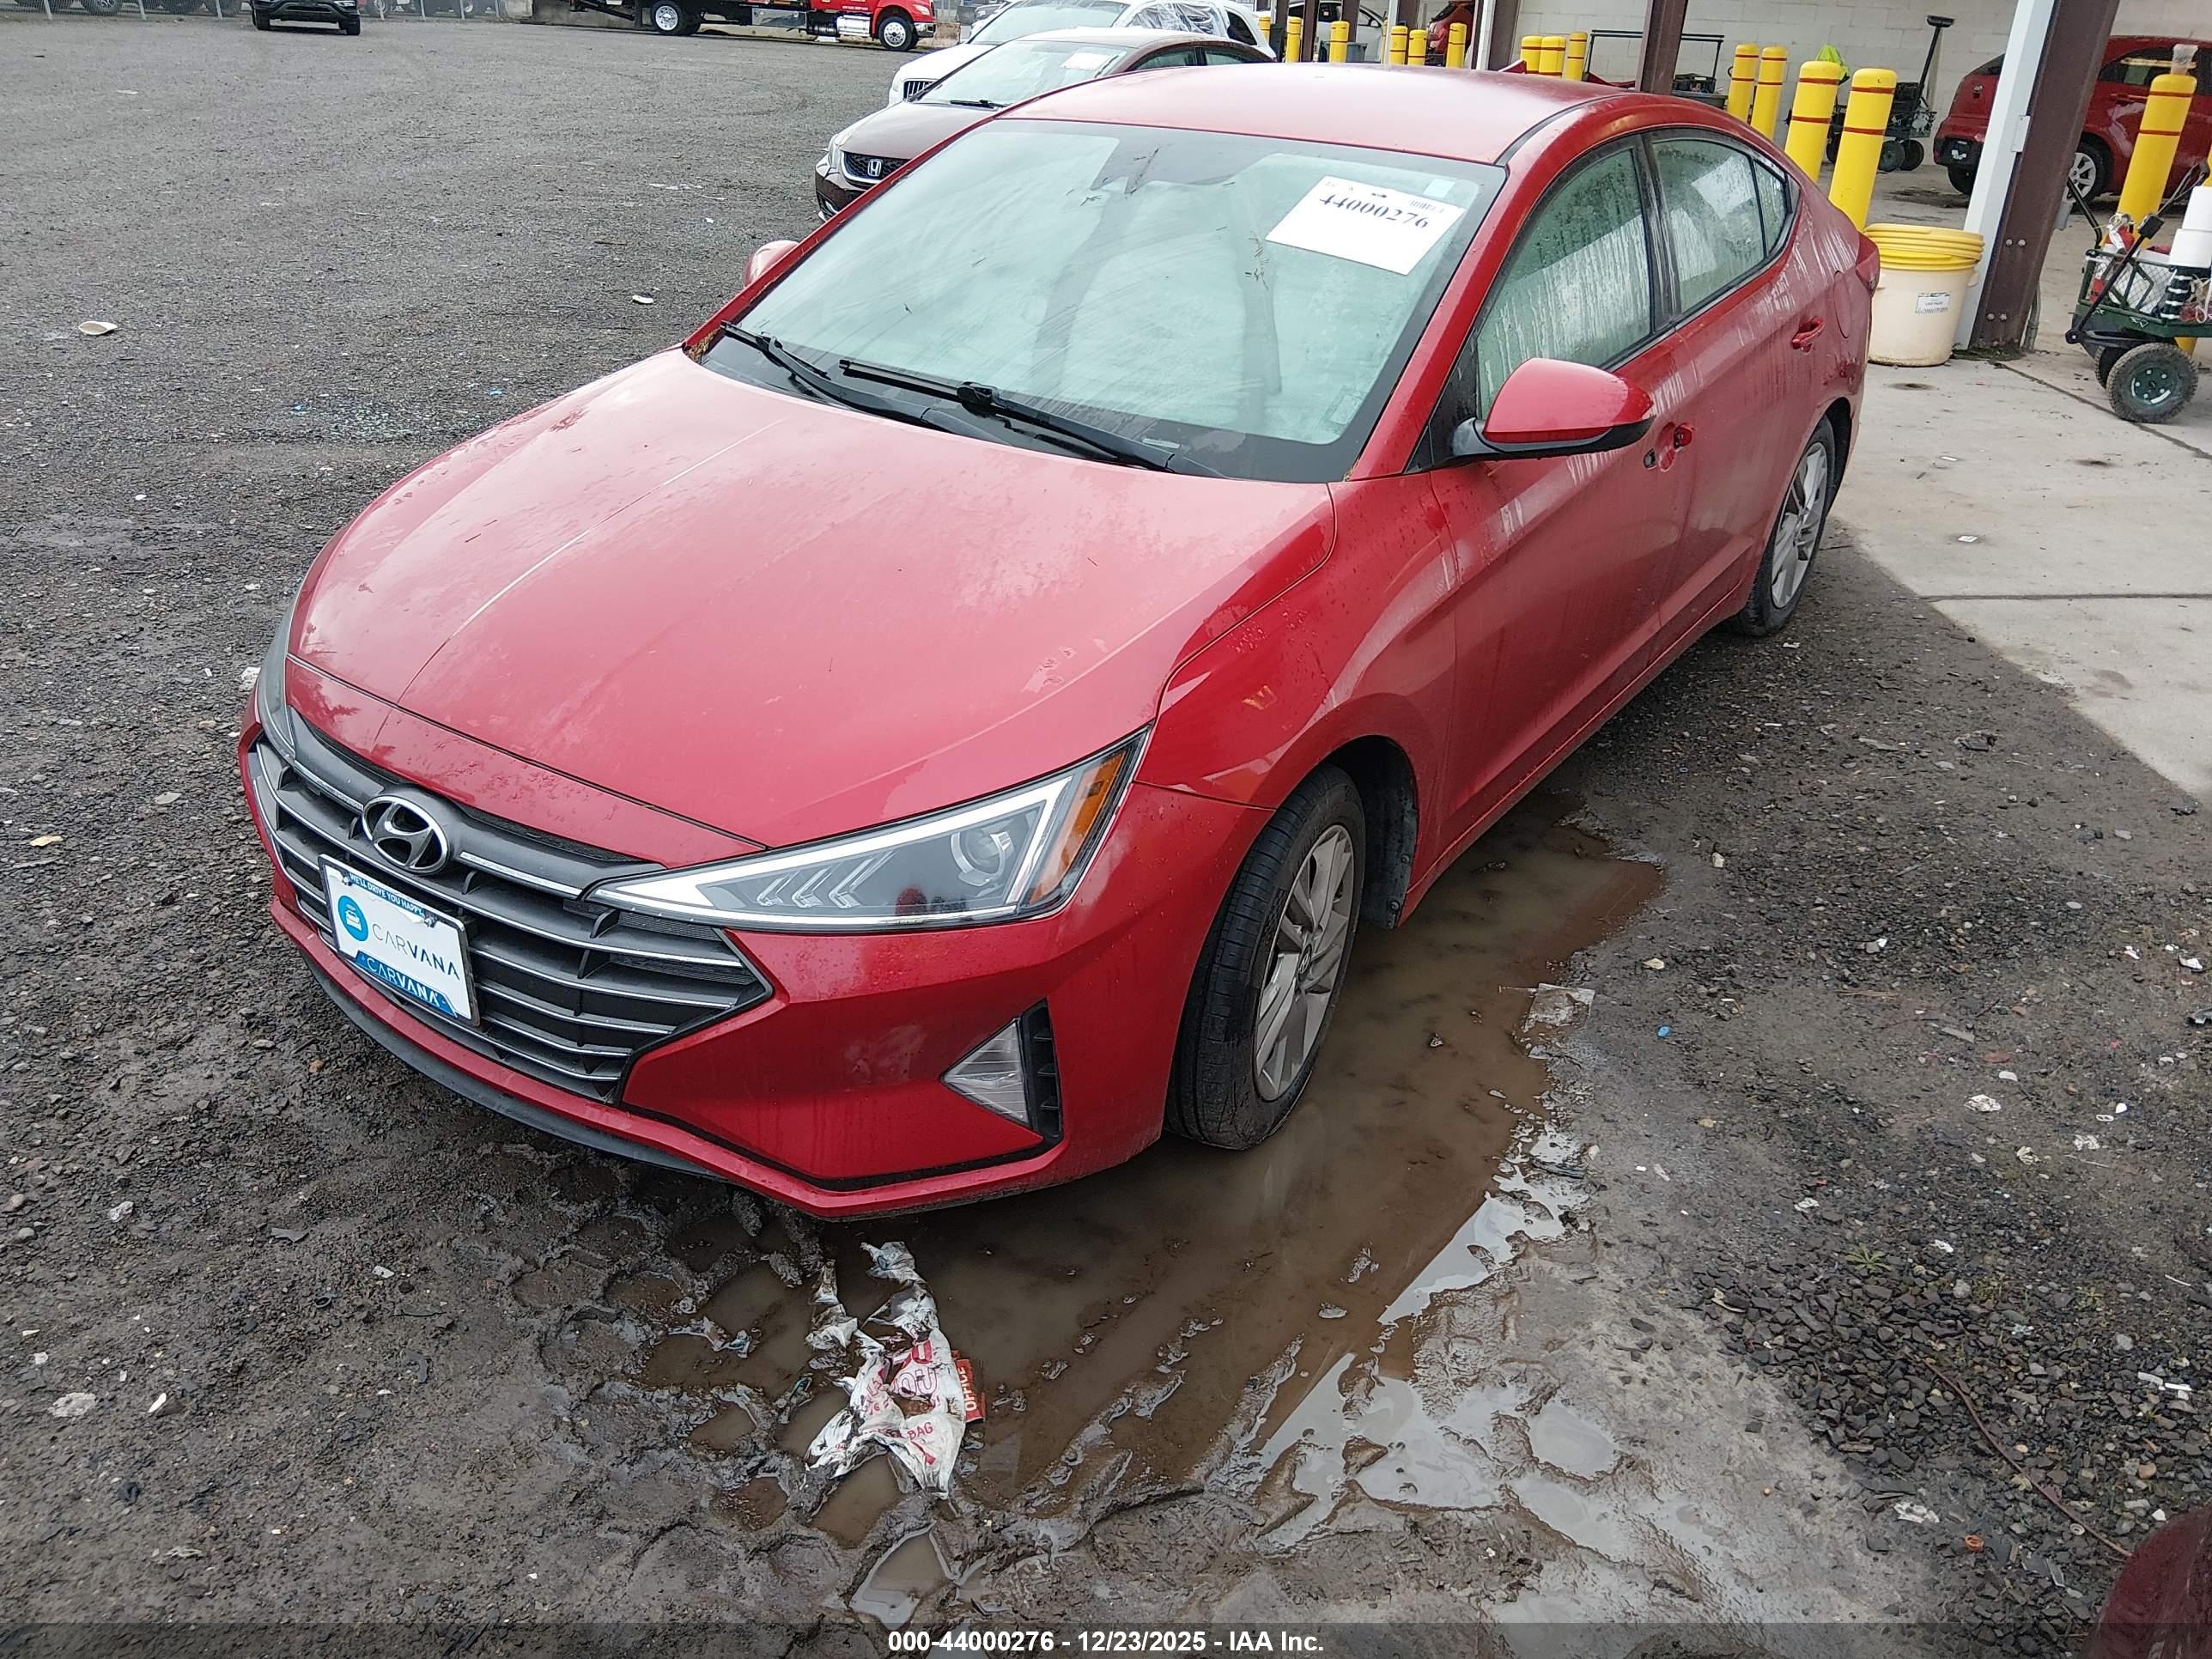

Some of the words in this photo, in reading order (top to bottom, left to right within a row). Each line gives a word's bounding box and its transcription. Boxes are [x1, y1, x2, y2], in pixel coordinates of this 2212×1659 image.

[1319, 194, 1429, 228] 44000276
[349, 872, 367, 888] WE'LL
[367, 882, 386, 898] DRIVE
[386, 891, 401, 904] YOU
[372, 923, 460, 980] CARVANA
[367, 957, 441, 1007] CARVANA
[907, 1421, 933, 1440] BAG
